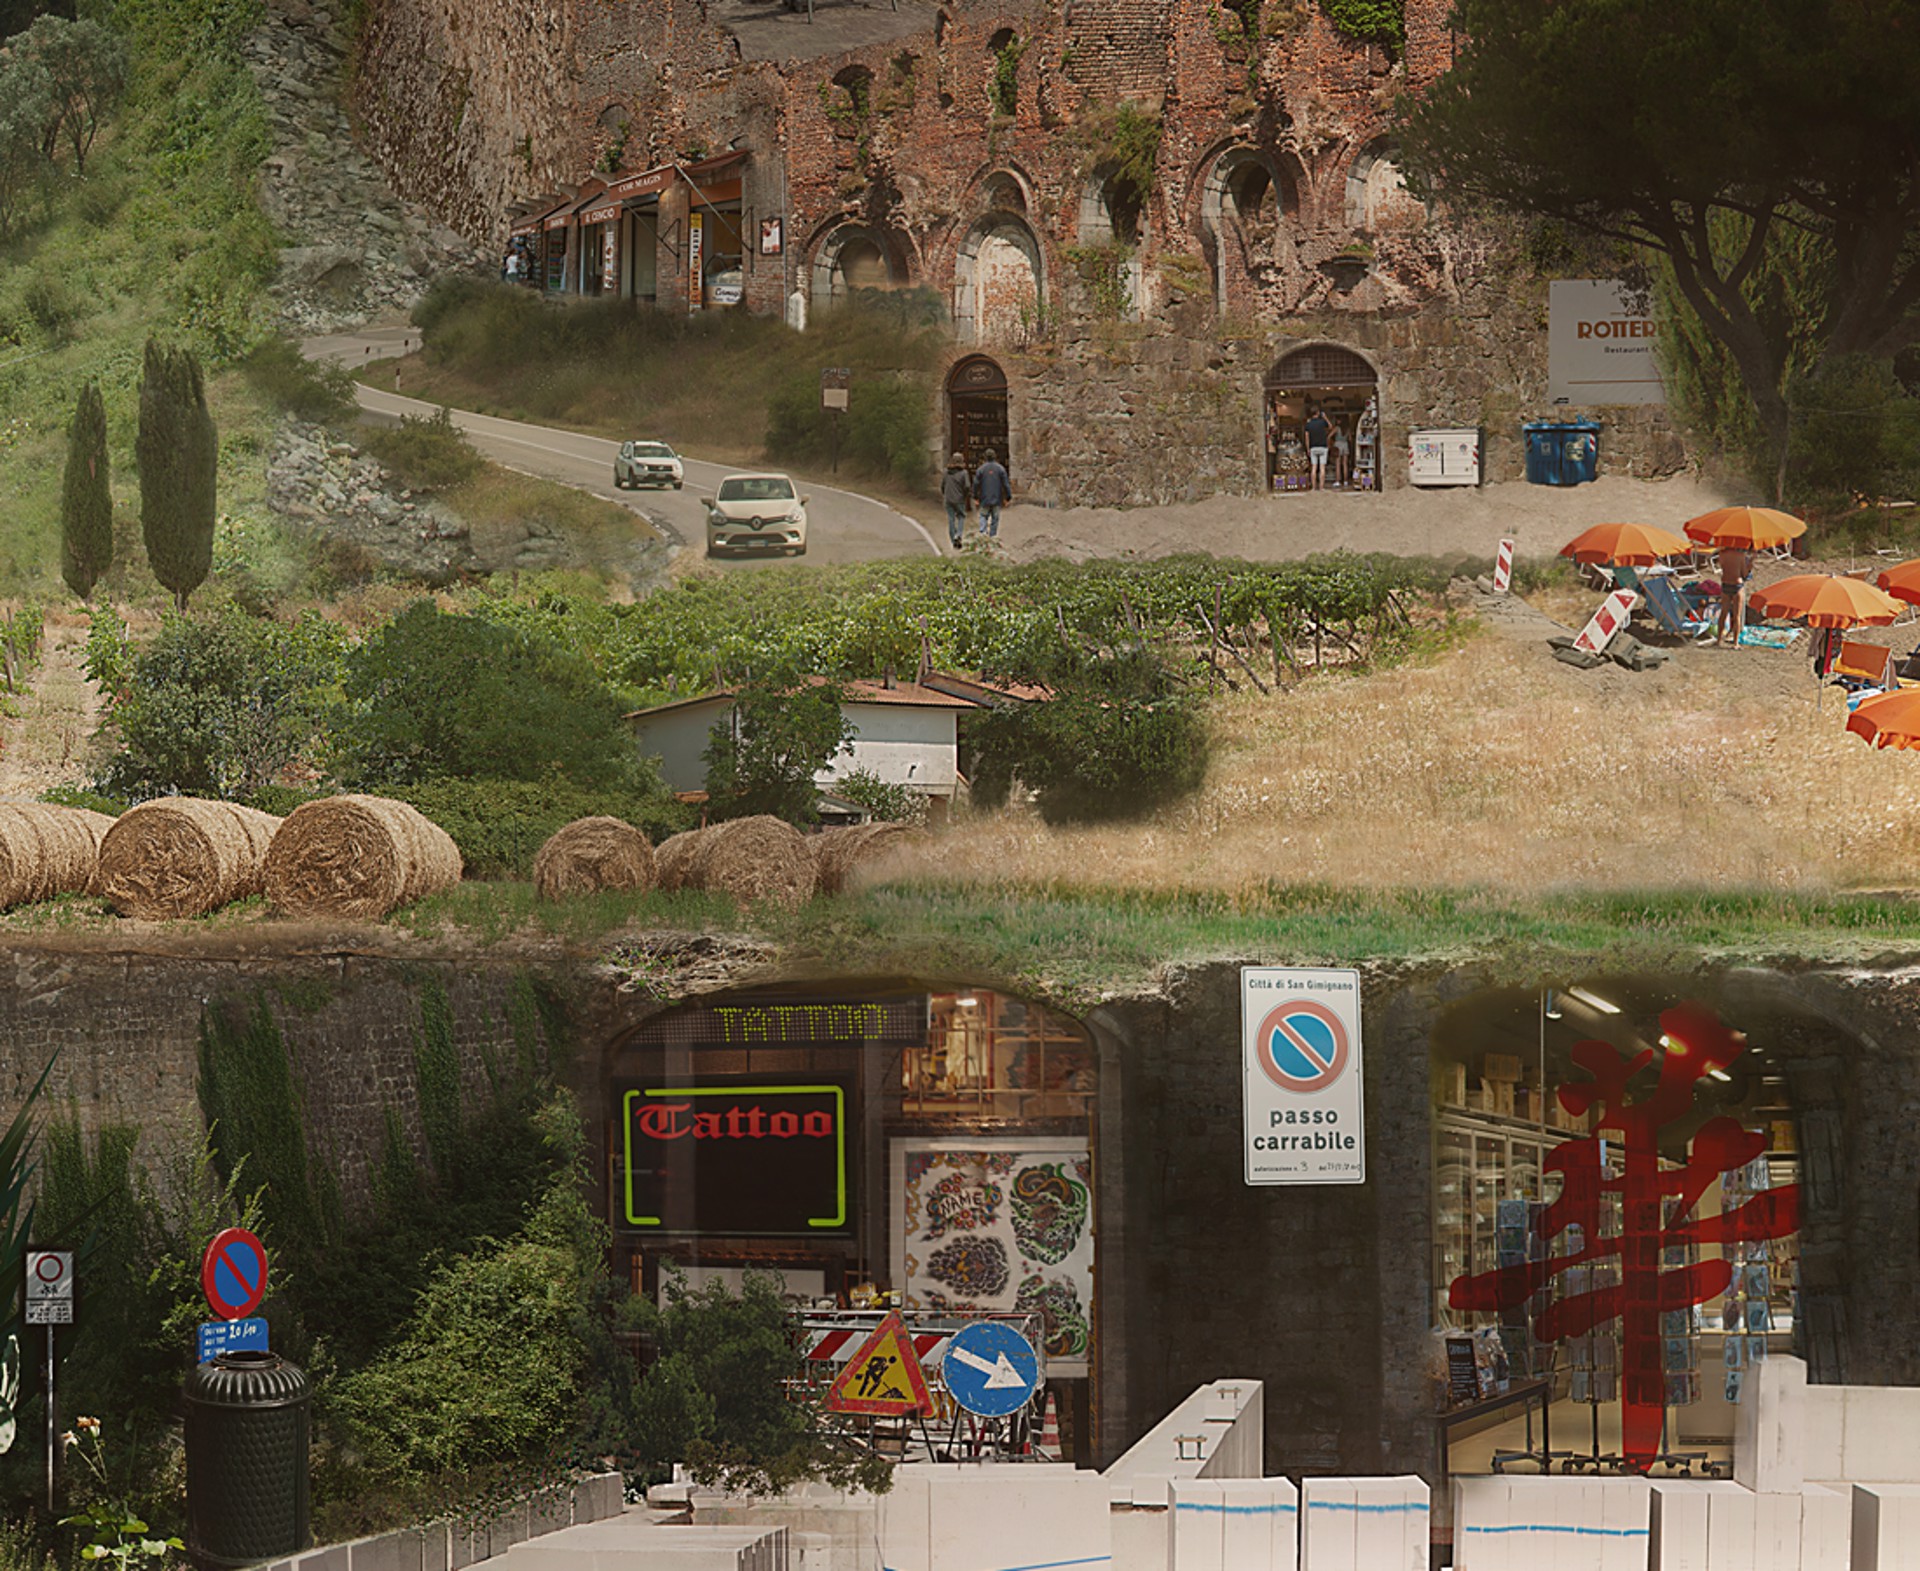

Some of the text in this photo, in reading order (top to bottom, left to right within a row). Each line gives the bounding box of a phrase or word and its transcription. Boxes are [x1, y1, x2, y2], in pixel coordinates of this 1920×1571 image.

[1604, 345, 1649, 354] Restaurant
[1249, 978, 1354, 992] Città di San Gimignano
[635, 1102, 833, 1140] Tattoo
[1270, 1109, 1338, 1127] passo
[1253, 1131, 1356, 1151] carrabile
[941, 1189, 983, 1214] NAME
